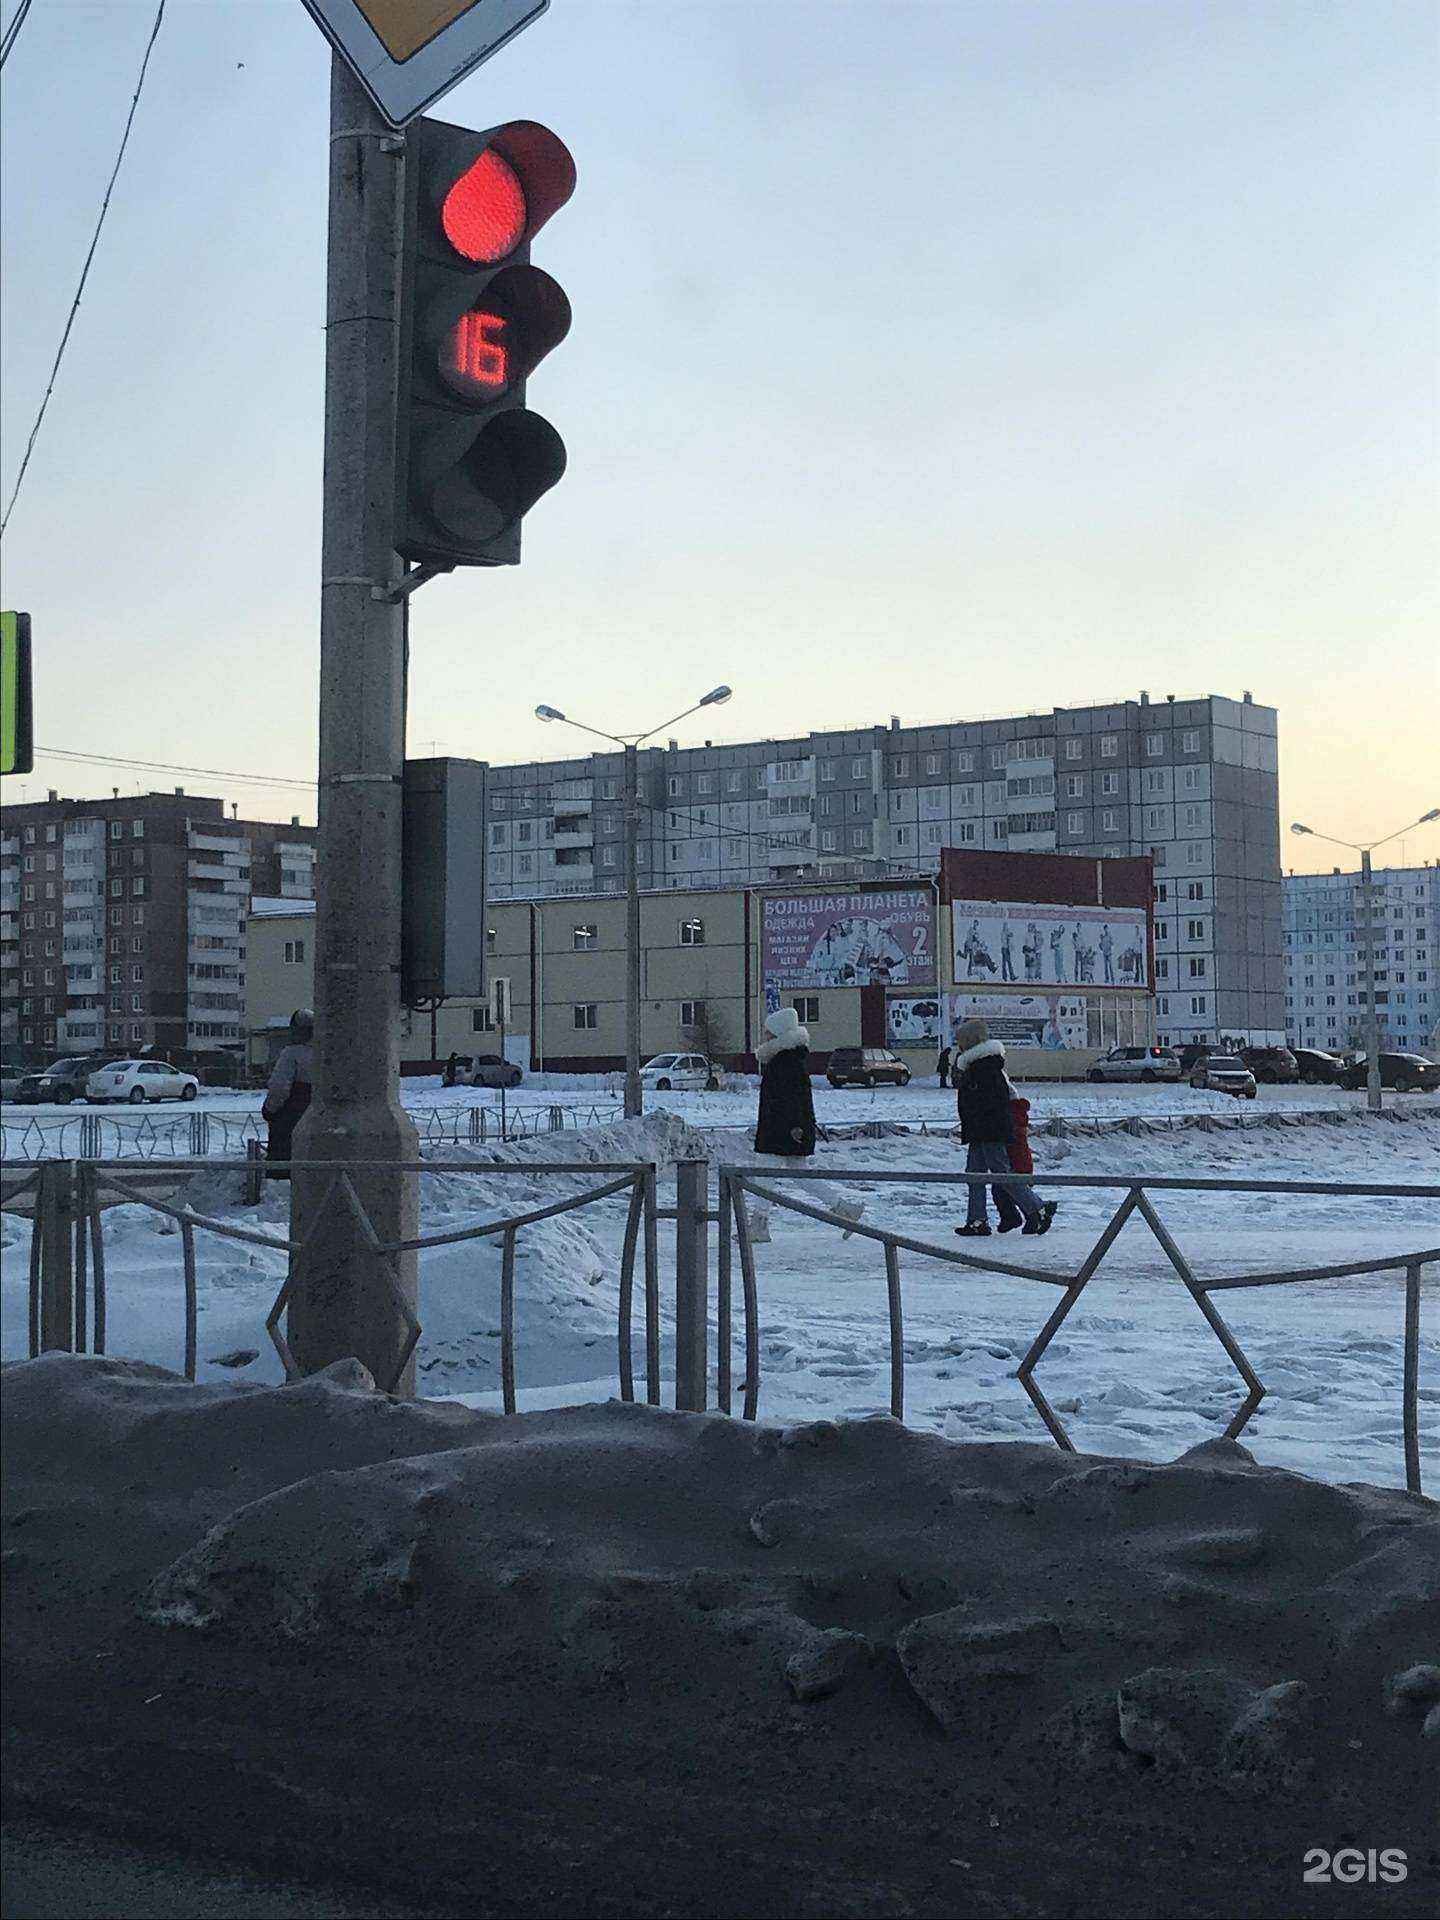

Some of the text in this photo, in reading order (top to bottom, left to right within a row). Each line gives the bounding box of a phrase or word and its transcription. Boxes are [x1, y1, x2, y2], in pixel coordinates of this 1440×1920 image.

[457, 312, 507, 384] 16
[764, 893, 929, 915] БОЛЬШАЯ ПЛАНЕТА
[764, 918, 815, 930] ОДЕЖДА
[890, 911, 930, 923] ОБУВЬ
[912, 926, 928, 956] 2
[907, 955, 933, 966] ЭТАЖ
